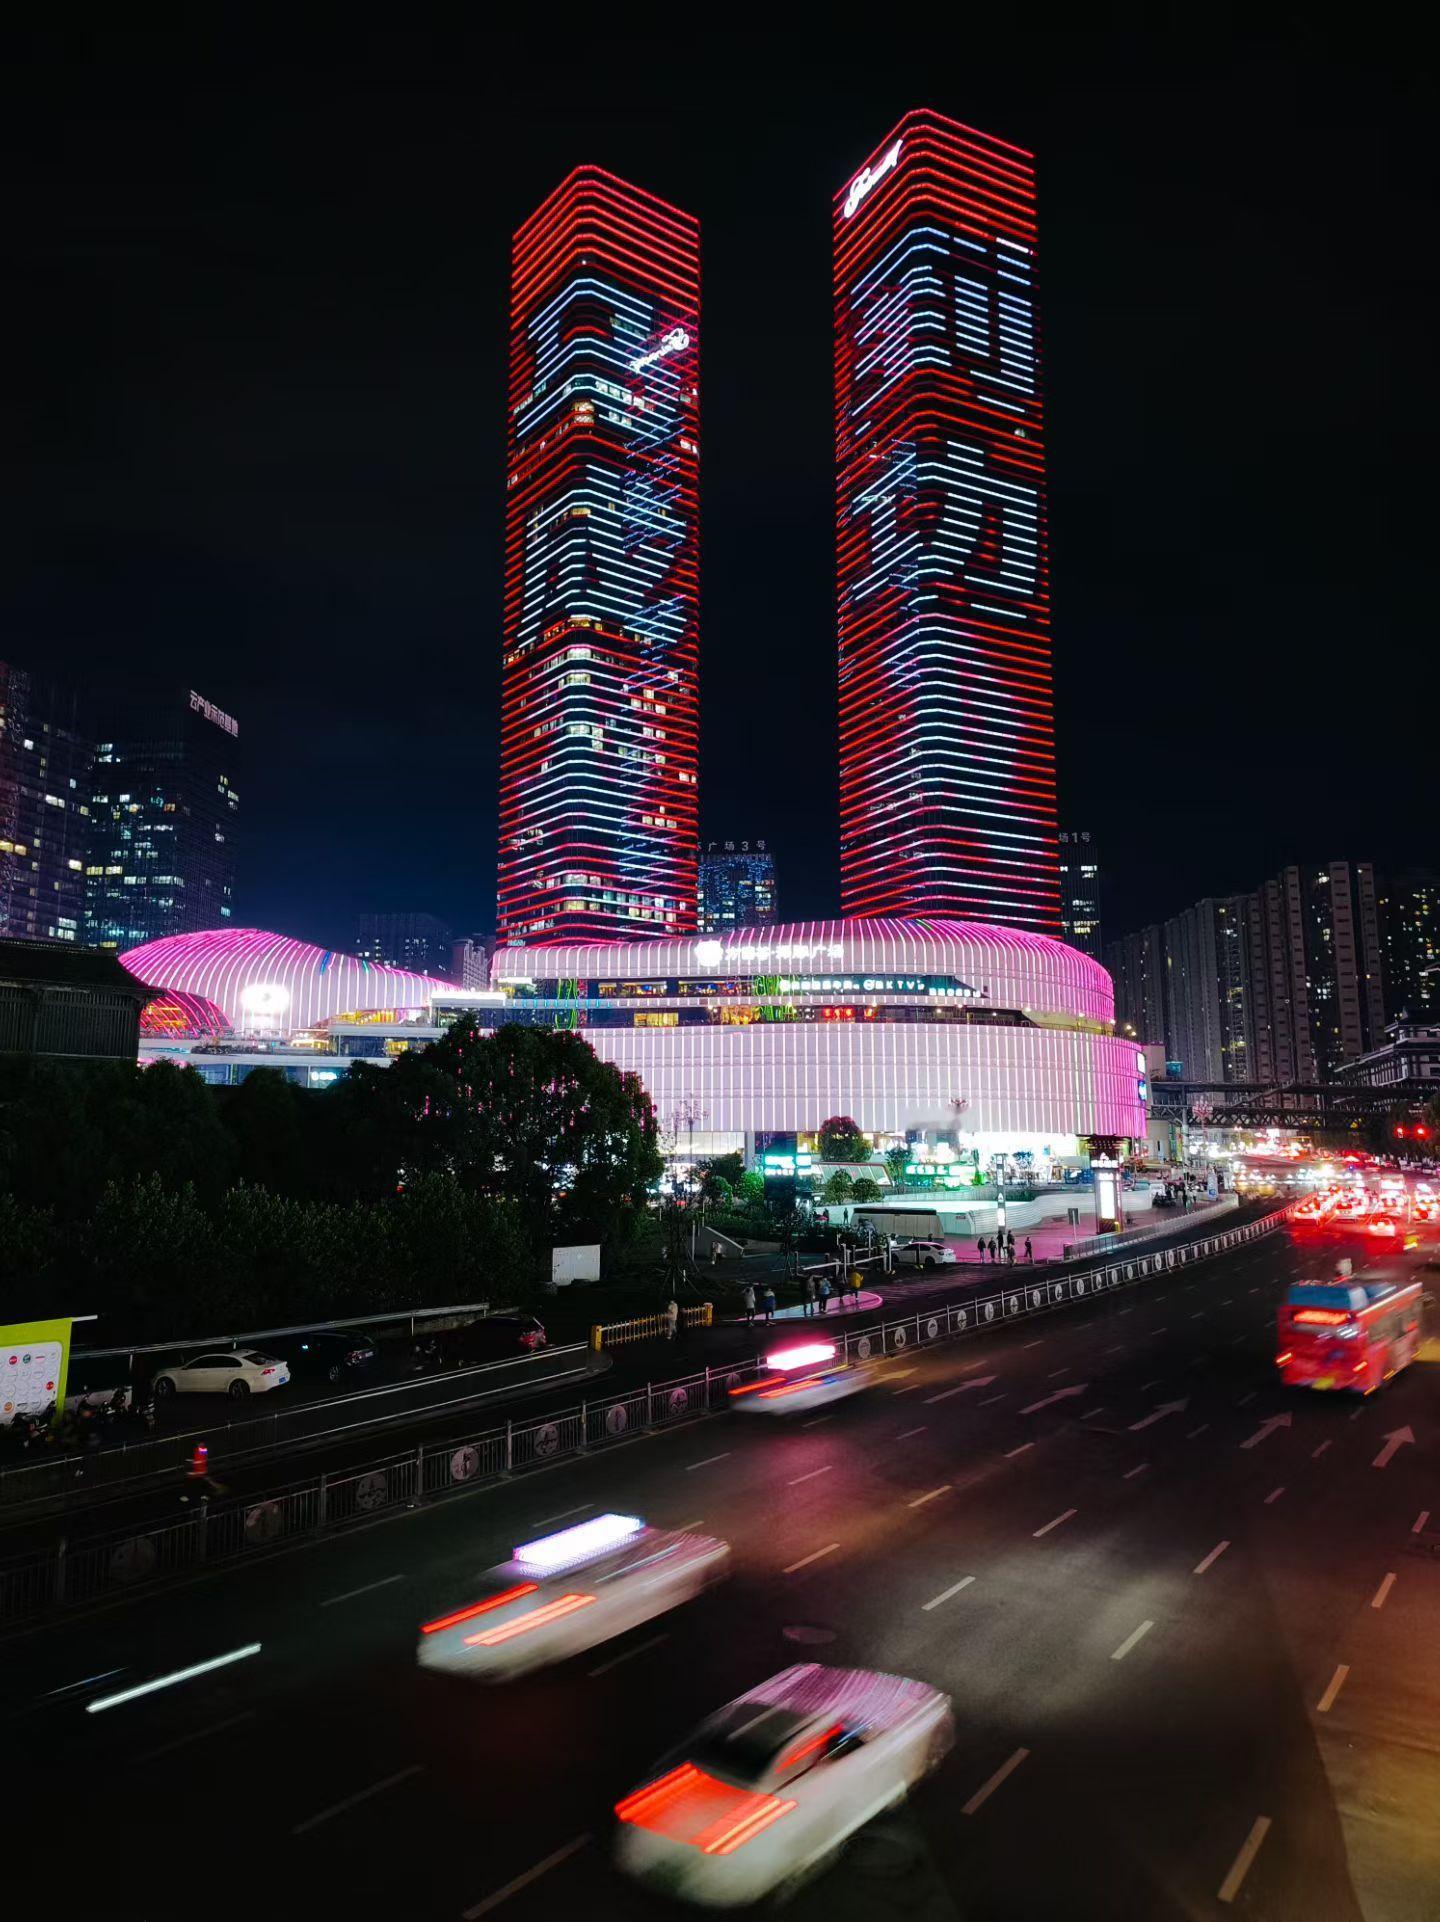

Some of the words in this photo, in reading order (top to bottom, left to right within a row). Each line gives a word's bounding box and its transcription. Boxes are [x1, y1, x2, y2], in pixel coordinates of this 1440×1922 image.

[851, 227, 1033, 434] 到
[852, 440, 1037, 618] 功
[190, 690, 238, 737] 云产业示范基地
